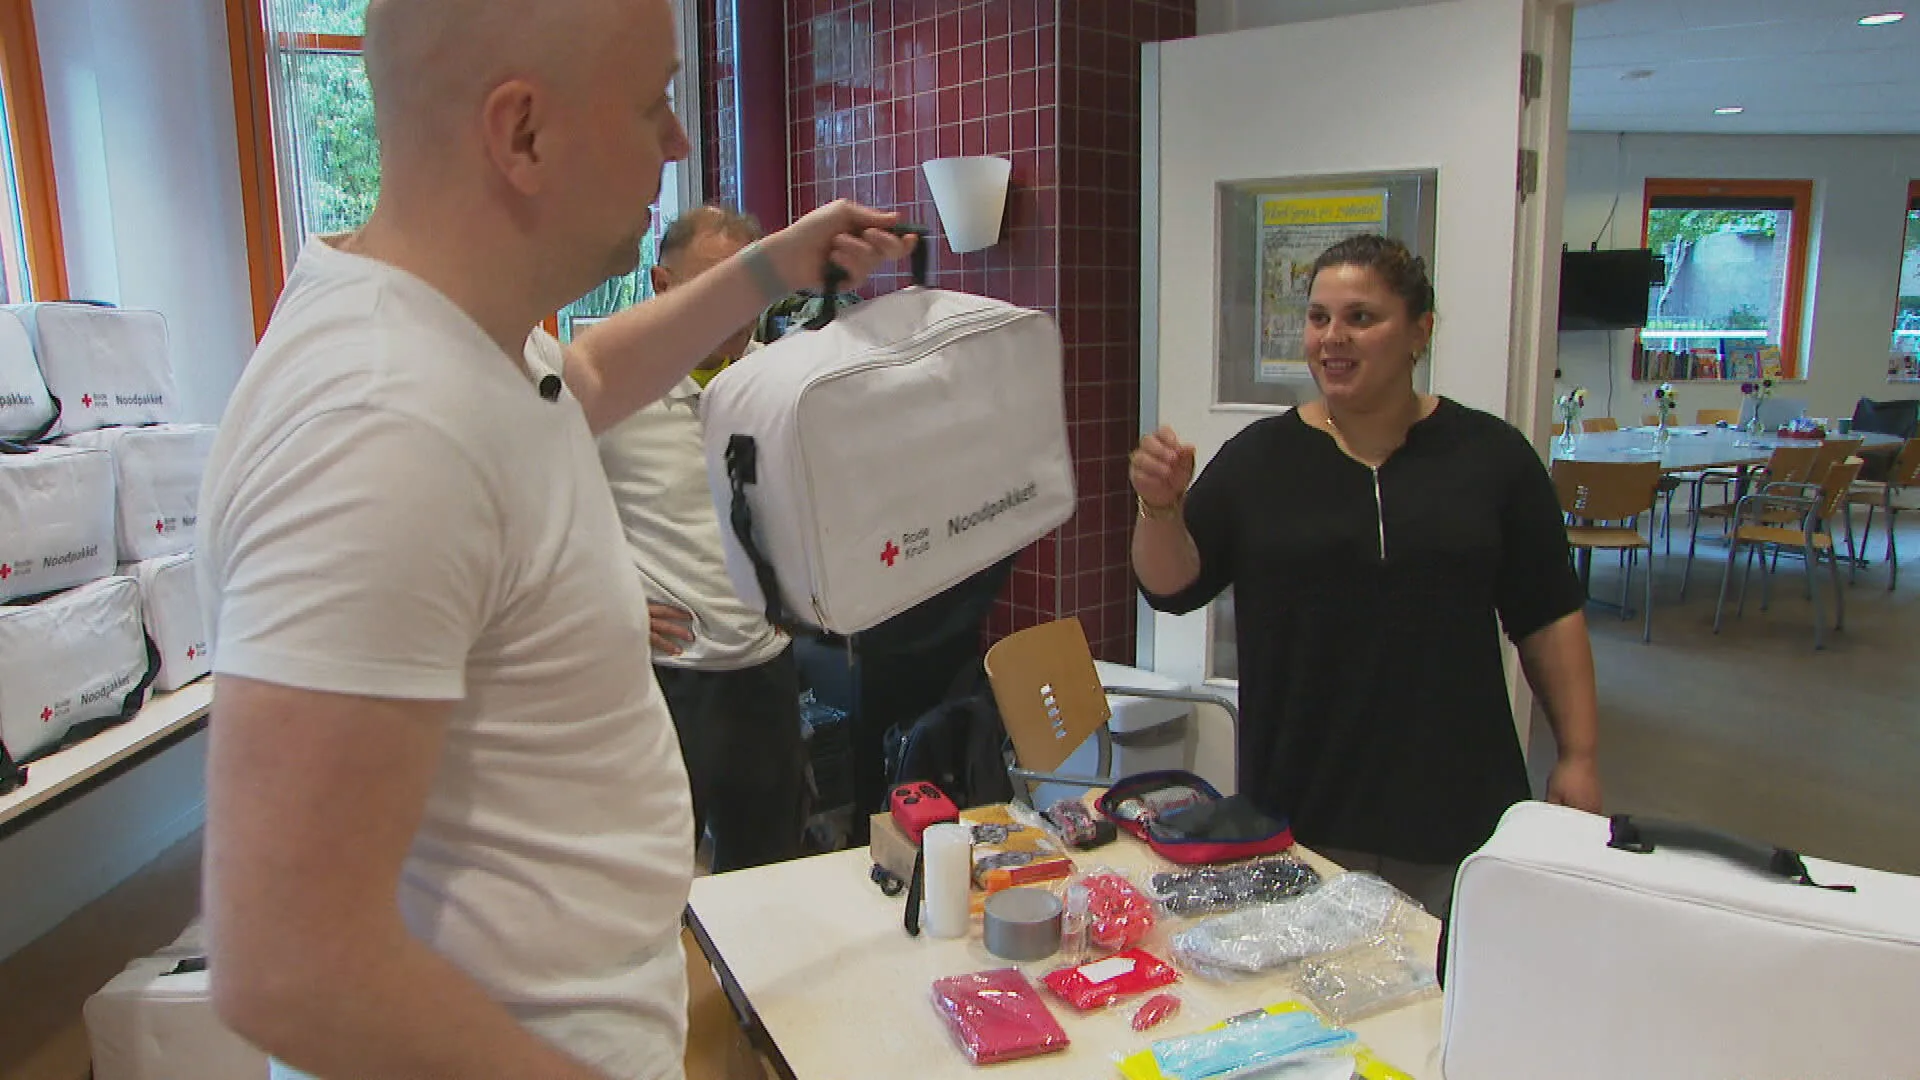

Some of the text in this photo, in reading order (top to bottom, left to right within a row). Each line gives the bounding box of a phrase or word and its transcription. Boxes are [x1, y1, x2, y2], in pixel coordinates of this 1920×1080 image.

[116, 393, 163, 406] Noodpakket
[947, 480, 1037, 537] Noodpakket
[42, 544, 98, 568] Noodpakket
[81, 674, 130, 704] Noodpakket
